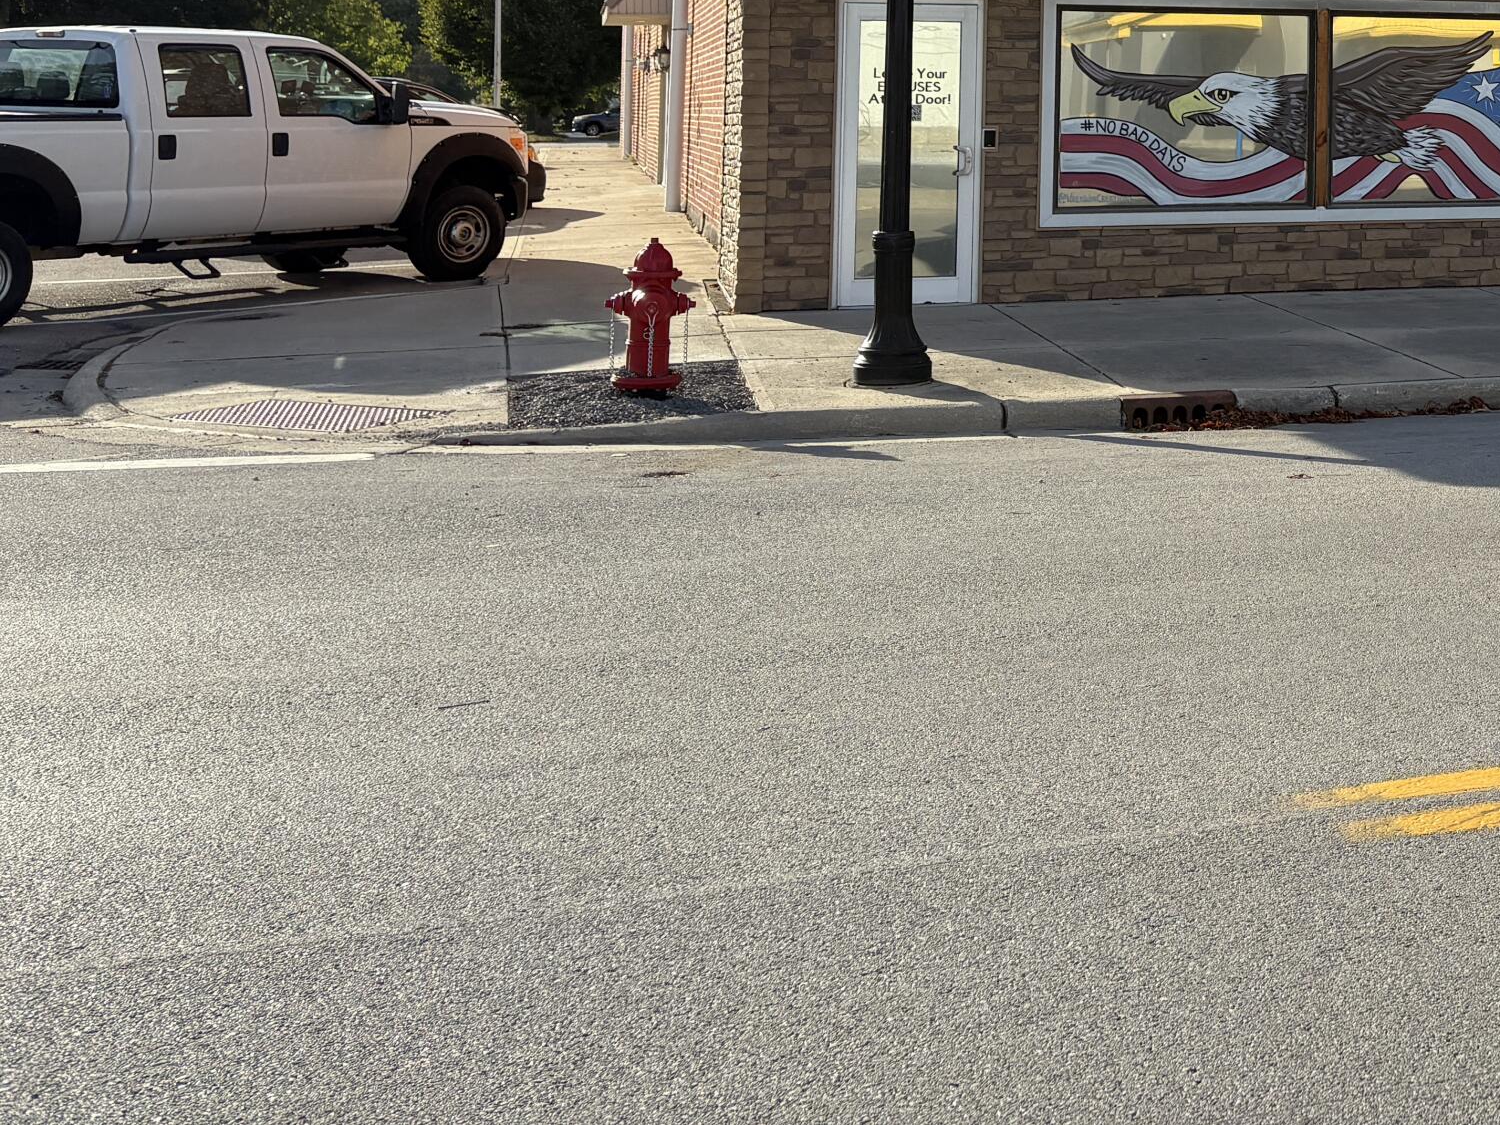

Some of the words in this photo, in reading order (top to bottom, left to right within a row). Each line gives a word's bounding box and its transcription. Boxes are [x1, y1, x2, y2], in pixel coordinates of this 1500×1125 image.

[917, 67, 947, 79] Your
[877, 81, 941, 93] EUSES
[915, 93, 951, 105] Door!
[1080, 119, 1116, 134] #NO
[1119, 123, 1149, 143] BAD
[1148, 139, 1187, 172] DAYS
